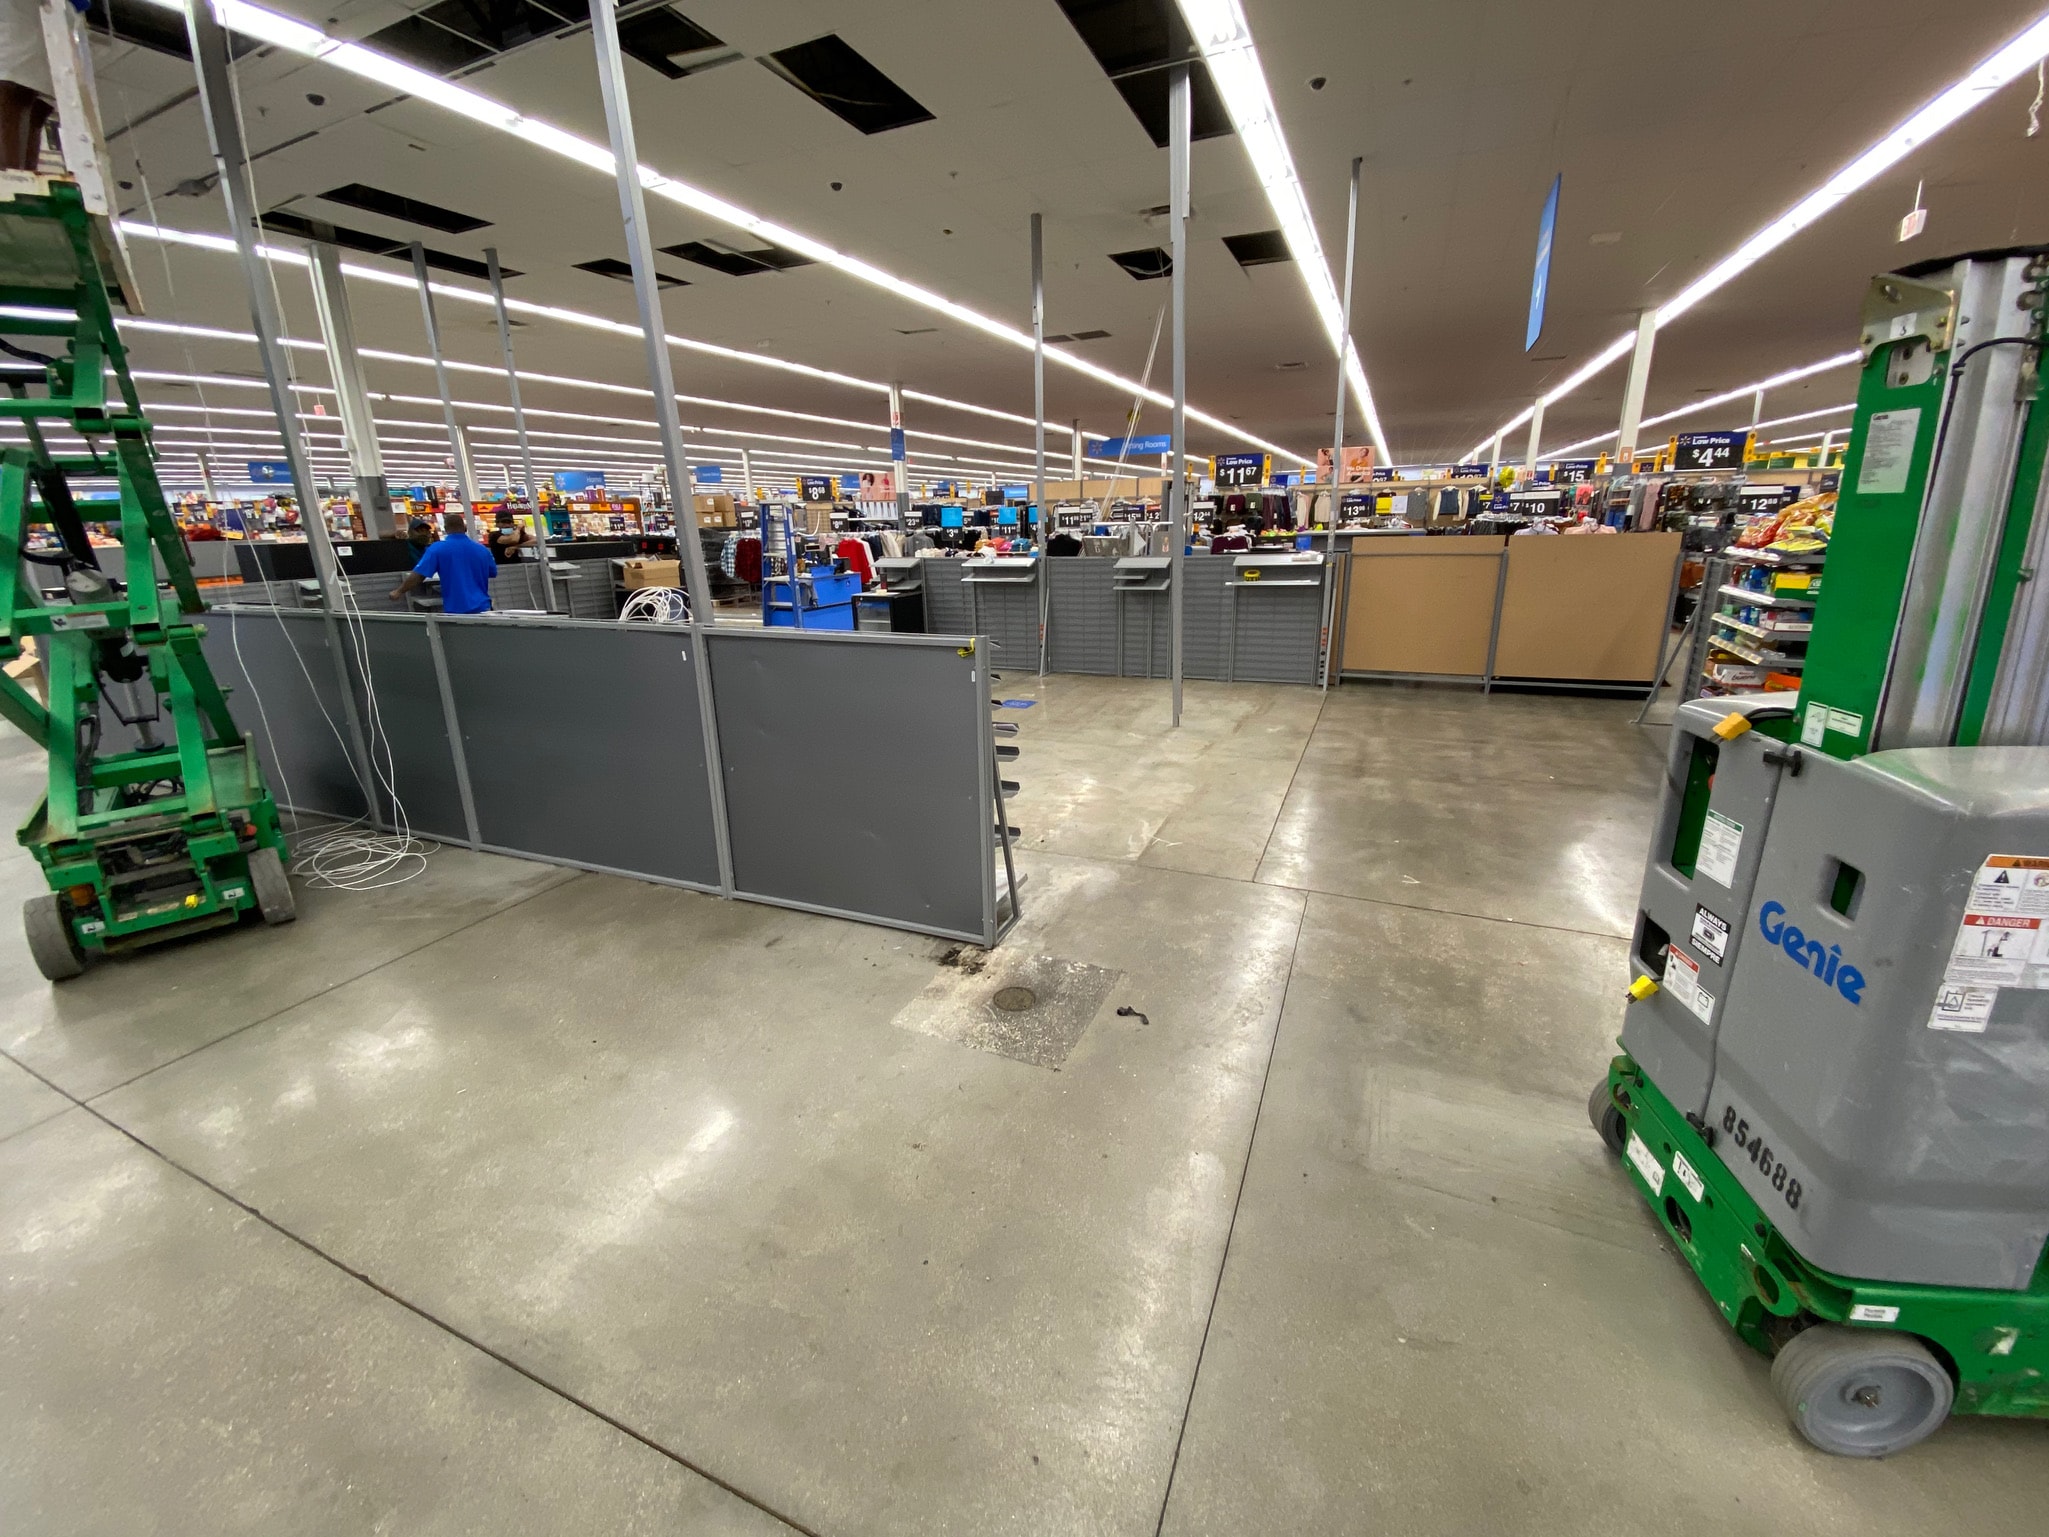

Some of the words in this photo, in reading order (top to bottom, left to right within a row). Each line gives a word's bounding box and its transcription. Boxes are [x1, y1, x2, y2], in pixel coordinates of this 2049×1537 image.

[1692, 437, 1709, 445] Low
[1710, 436, 1731, 445] Price
[1698, 907, 1728, 932] ALWAYS
[1986, 916, 2031, 928] DANGER
[1759, 900, 1866, 1007] Genie
[1722, 1105, 1803, 1211] 854688
